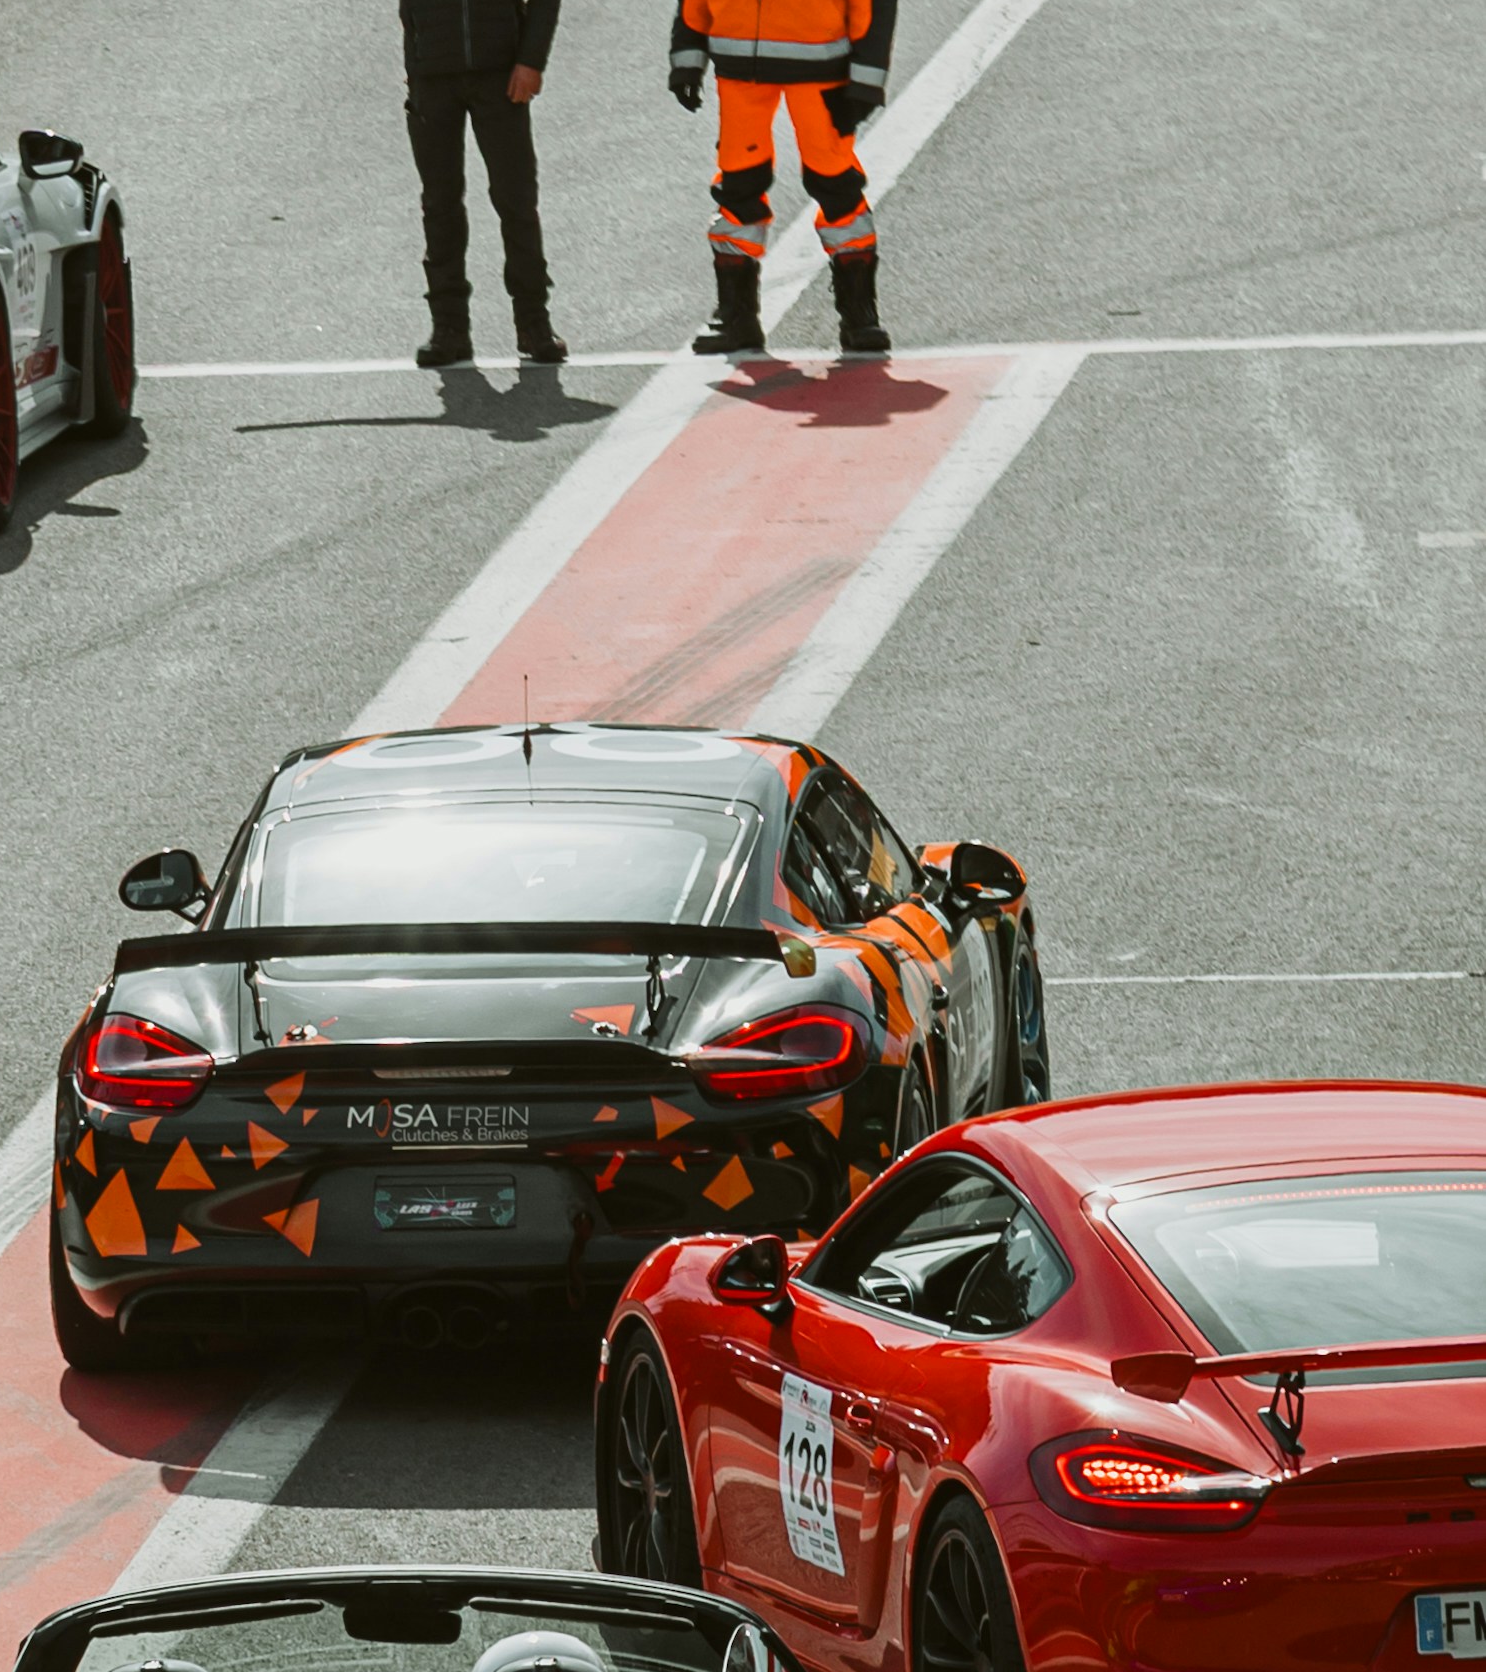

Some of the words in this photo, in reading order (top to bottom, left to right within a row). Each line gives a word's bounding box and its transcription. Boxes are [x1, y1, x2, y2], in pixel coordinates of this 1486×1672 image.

[447, 1105, 529, 1127] FREIN
[392, 1129, 458, 1142] Clutches
[462, 1129, 473, 1141] &
[477, 1128, 529, 1141] Brakes
[784, 1431, 827, 1517] 128
